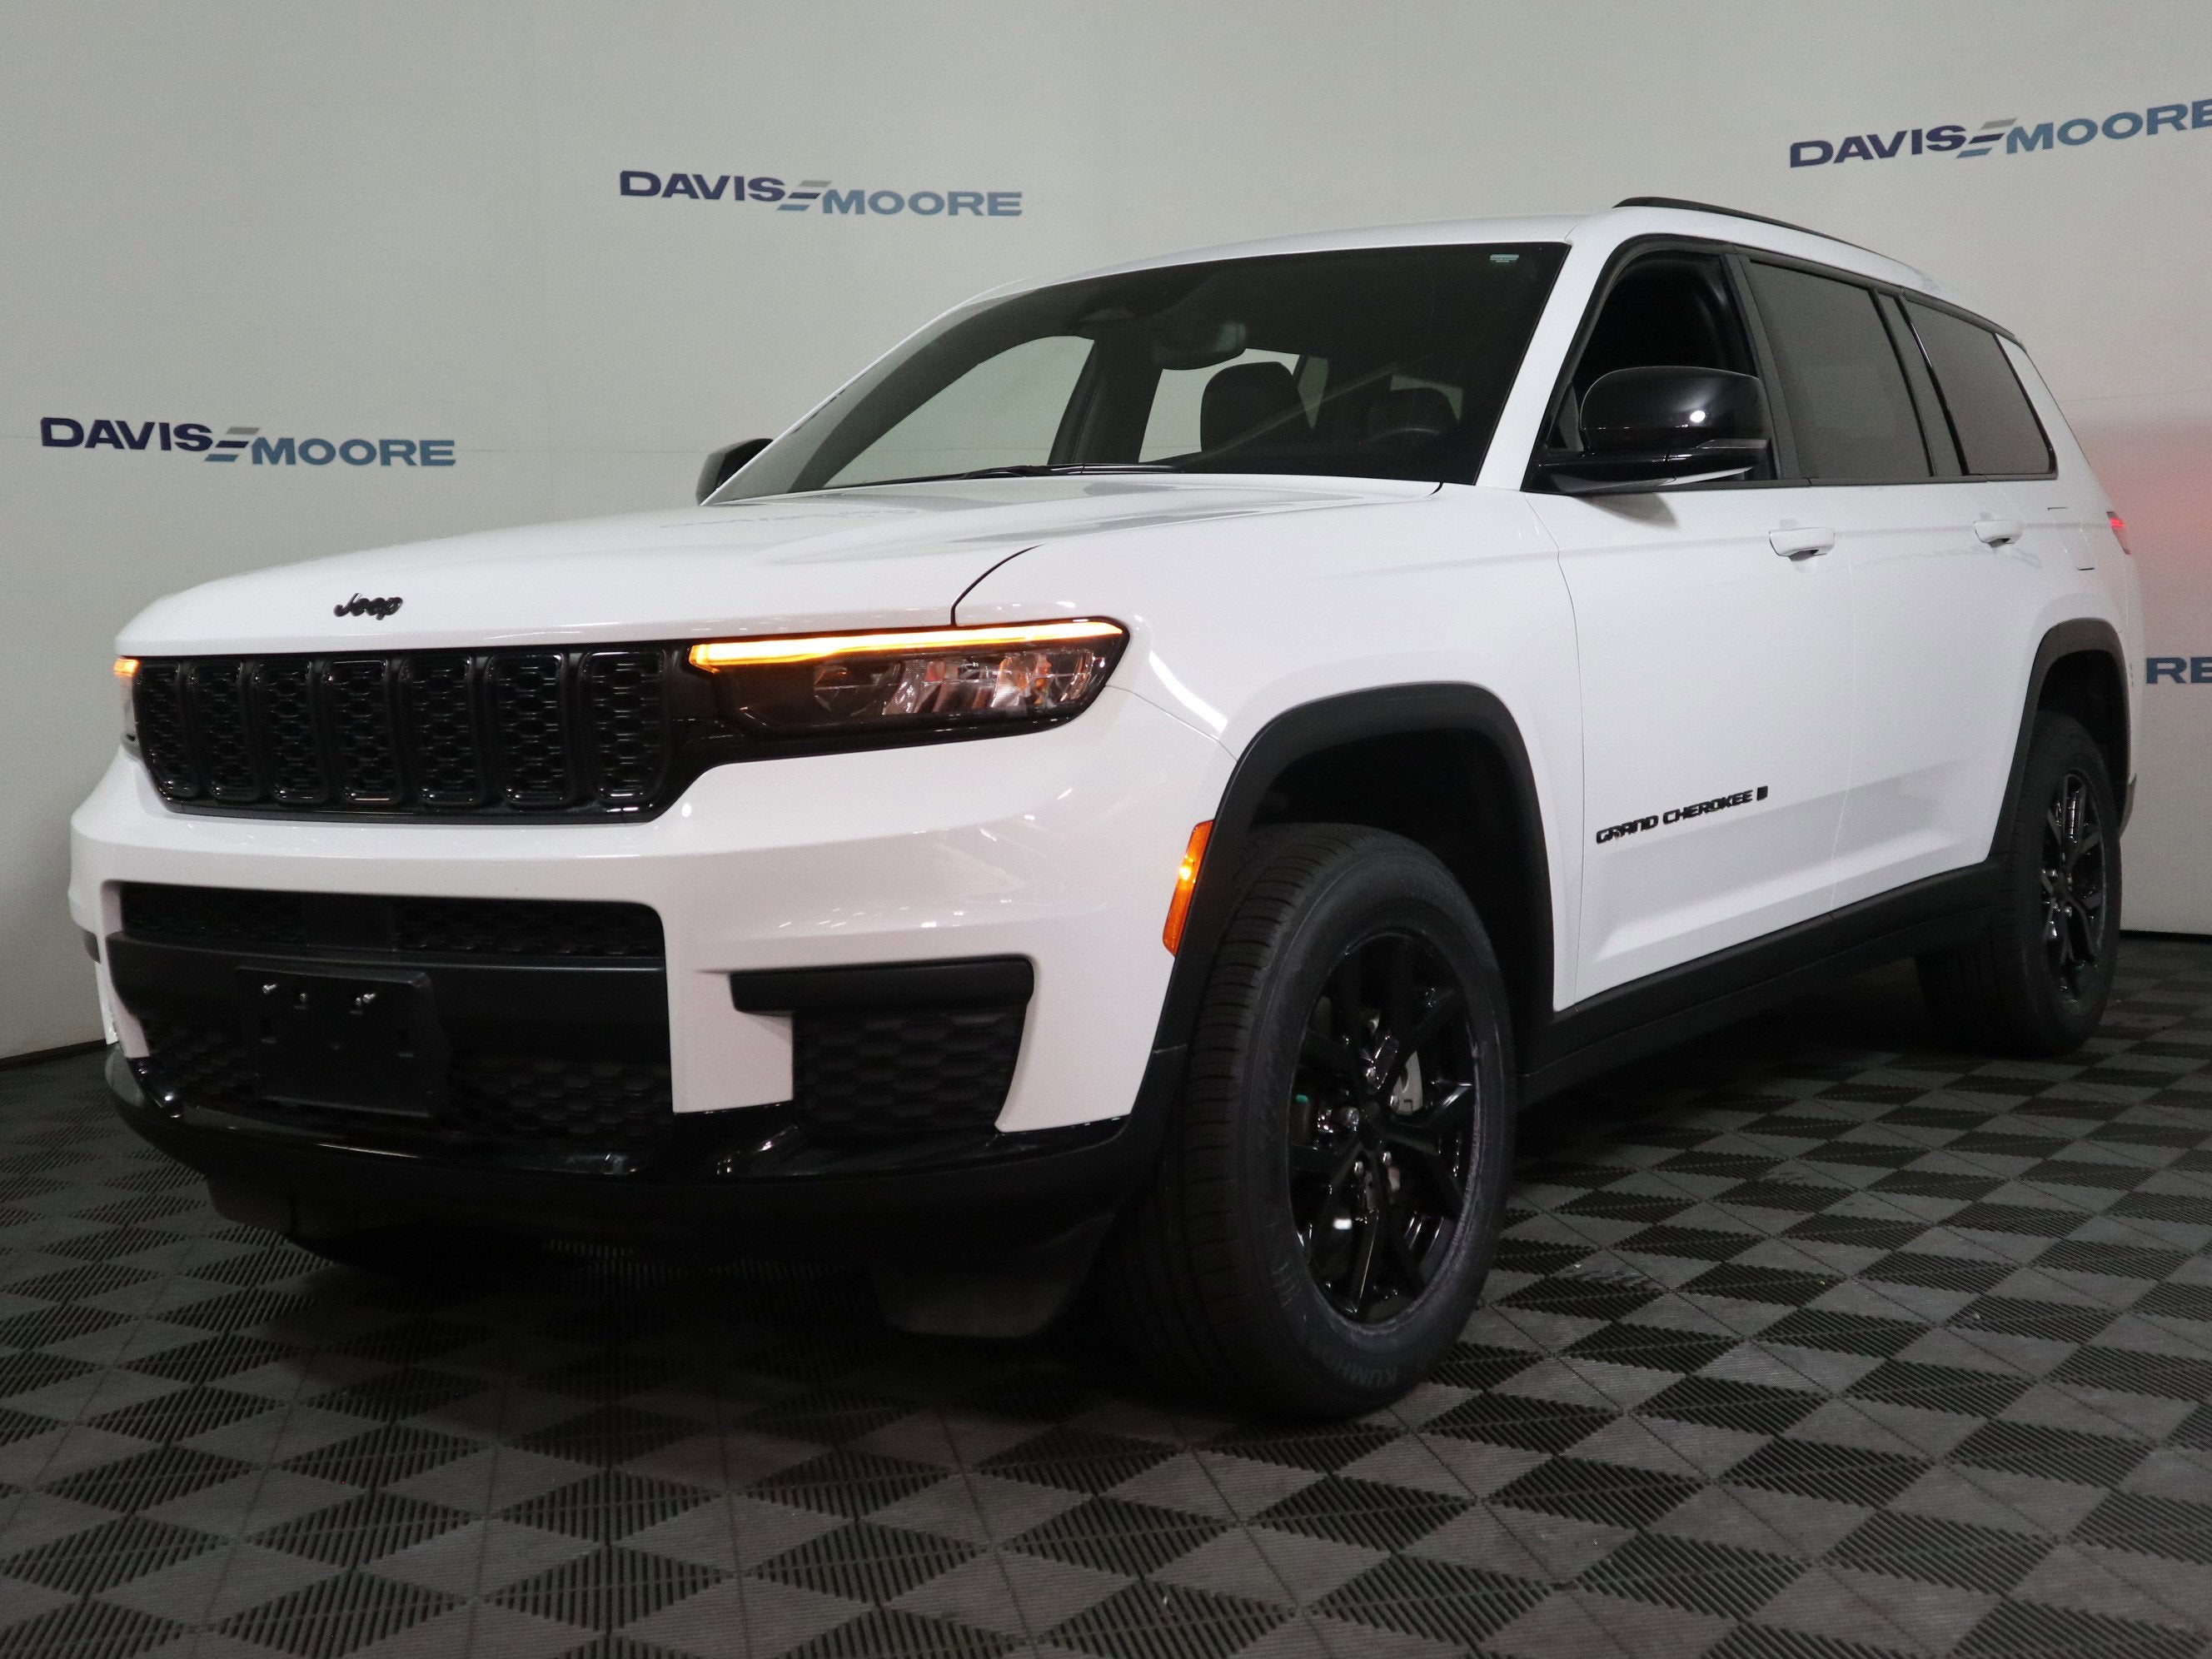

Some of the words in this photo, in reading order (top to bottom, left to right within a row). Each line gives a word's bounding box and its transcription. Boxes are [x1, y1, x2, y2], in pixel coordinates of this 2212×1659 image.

[1789, 124, 1967, 169] DAVIS
[619, 169, 786, 203] DAVIS
[822, 188, 1023, 217] MOORE
[39, 416, 214, 453] DAVIS
[250, 436, 456, 467] MOORE
[333, 592, 404, 621] Jeep
[1595, 815, 1659, 844] GRAND
[1662, 789, 1754, 825] CHEROKEE
